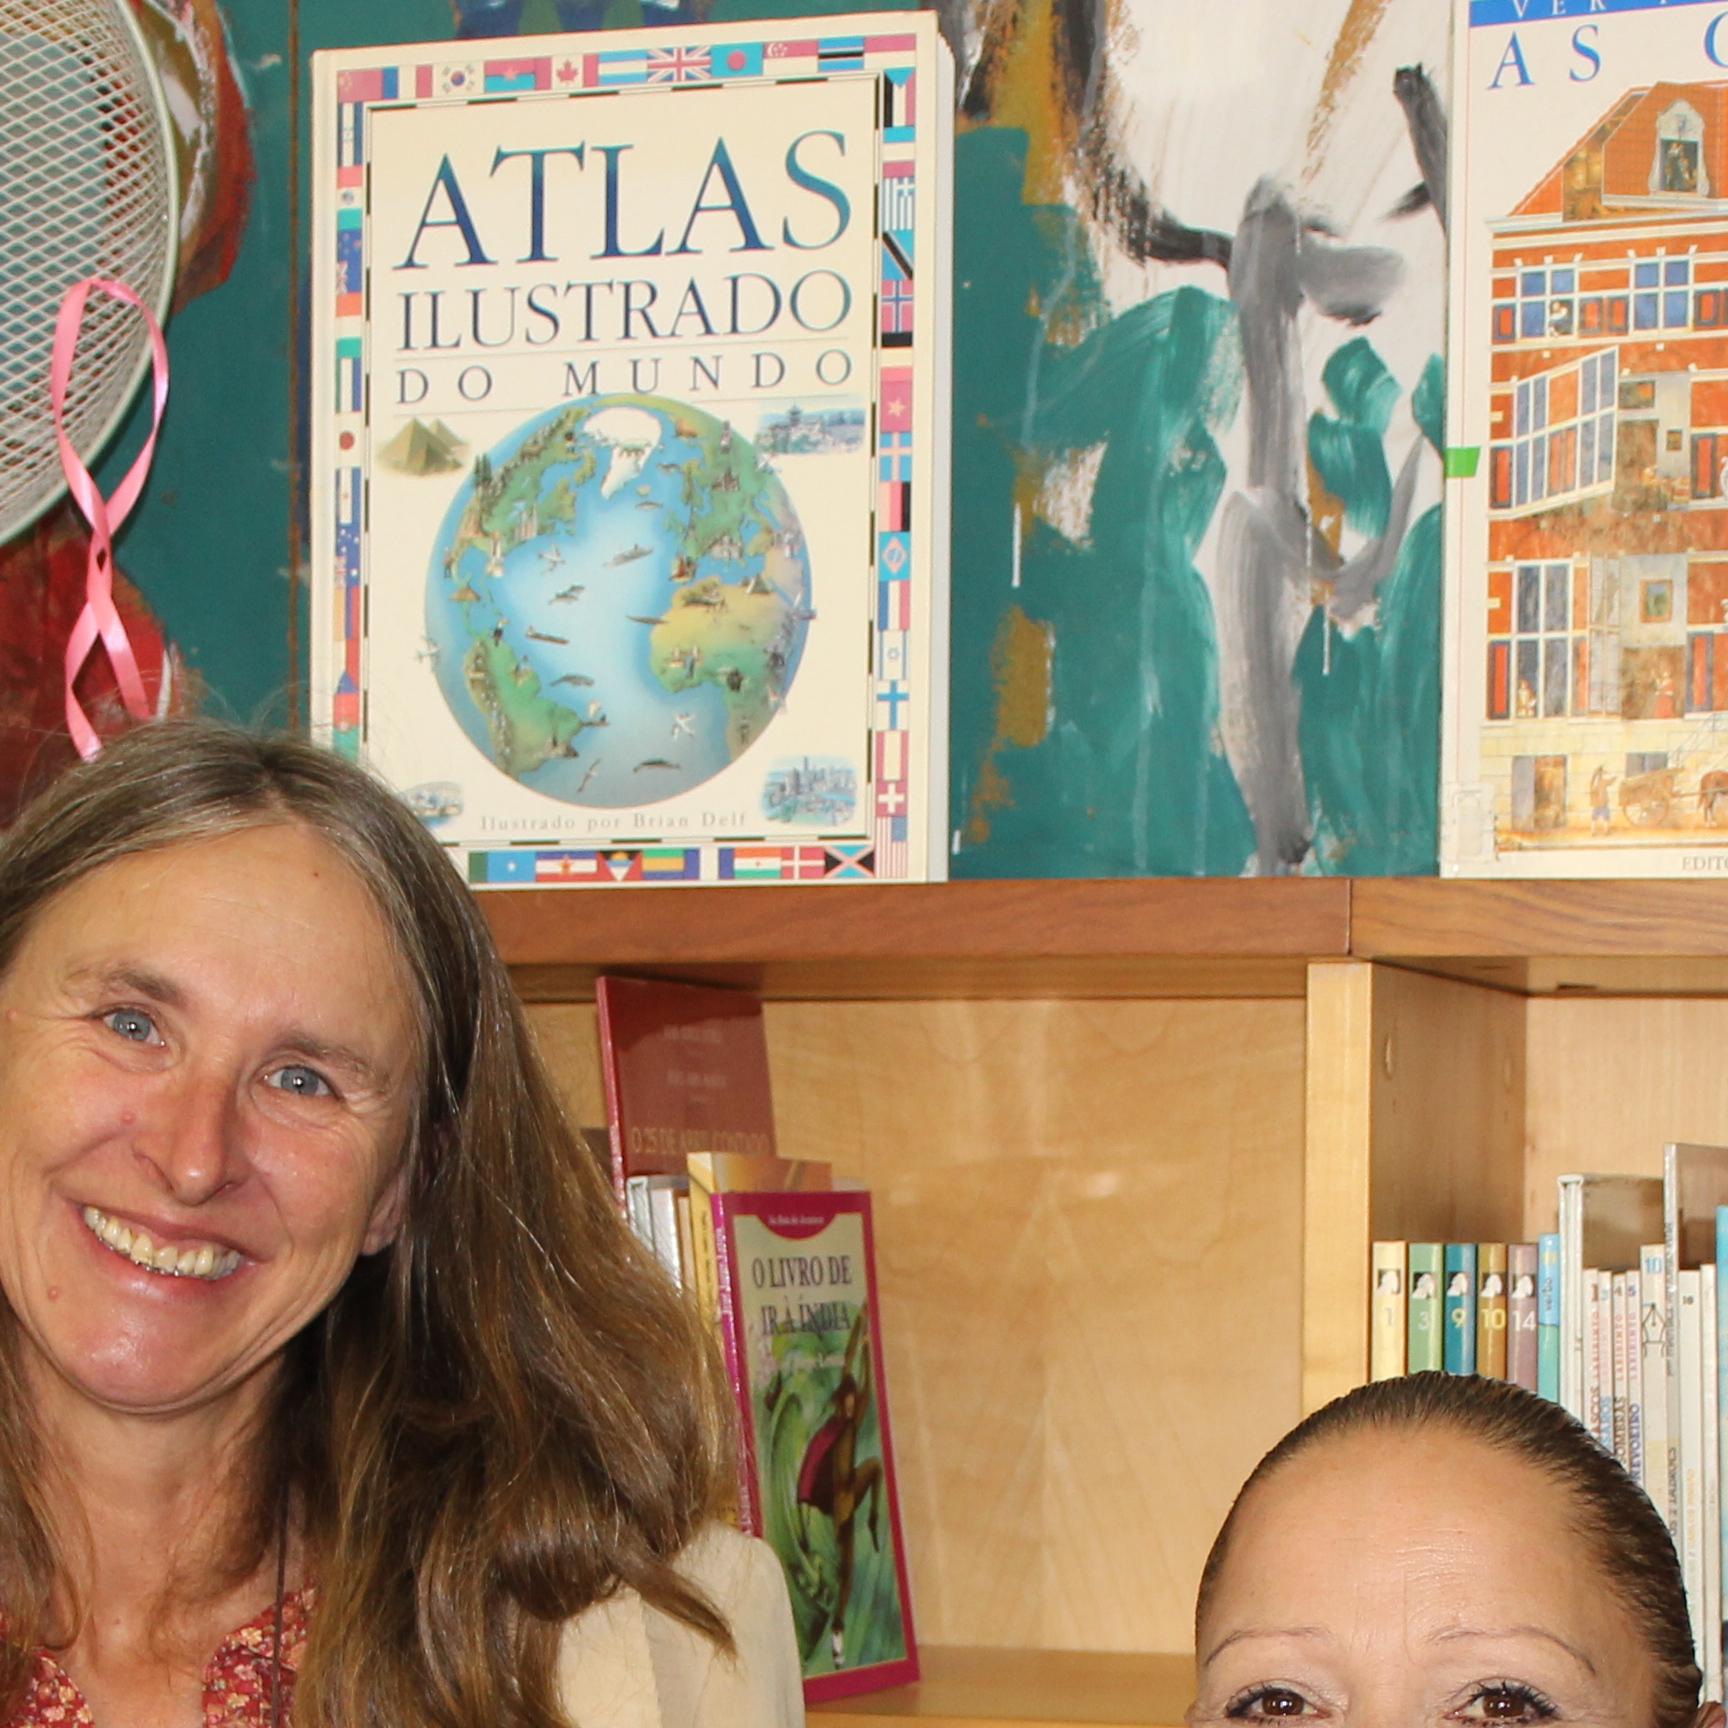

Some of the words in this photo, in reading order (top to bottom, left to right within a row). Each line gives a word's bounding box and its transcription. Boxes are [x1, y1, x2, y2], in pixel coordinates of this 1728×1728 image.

[1486, 24, 1603, 91] AS
[392, 130, 852, 271] ATLAS
[396, 269, 852, 352] ILUSTRADO
[396, 365, 493, 405] DO
[563, 348, 852, 398] MUNDO
[481, 814, 577, 832] Ilustrado
[586, 815, 622, 832] por
[633, 812, 690, 829] Brian
[701, 810, 749, 828] Delf
[752, 1257, 766, 1288] O
[769, 1254, 823, 1288] LIVRO
[827, 1254, 852, 1285] DE
[1644, 1256, 1663, 1275] 10
[761, 1303, 780, 1336] IR
[1418, 1310, 1431, 1331] 3
[1451, 1308, 1467, 1329] 9
[1481, 1308, 1506, 1331] 10
[1511, 1310, 1537, 1332] 14
[1591, 1311, 1600, 1380] LABIRINTO
[1614, 1313, 1625, 1382] LABIRINTO
[1627, 1312, 1638, 1381] LABIRINTO
